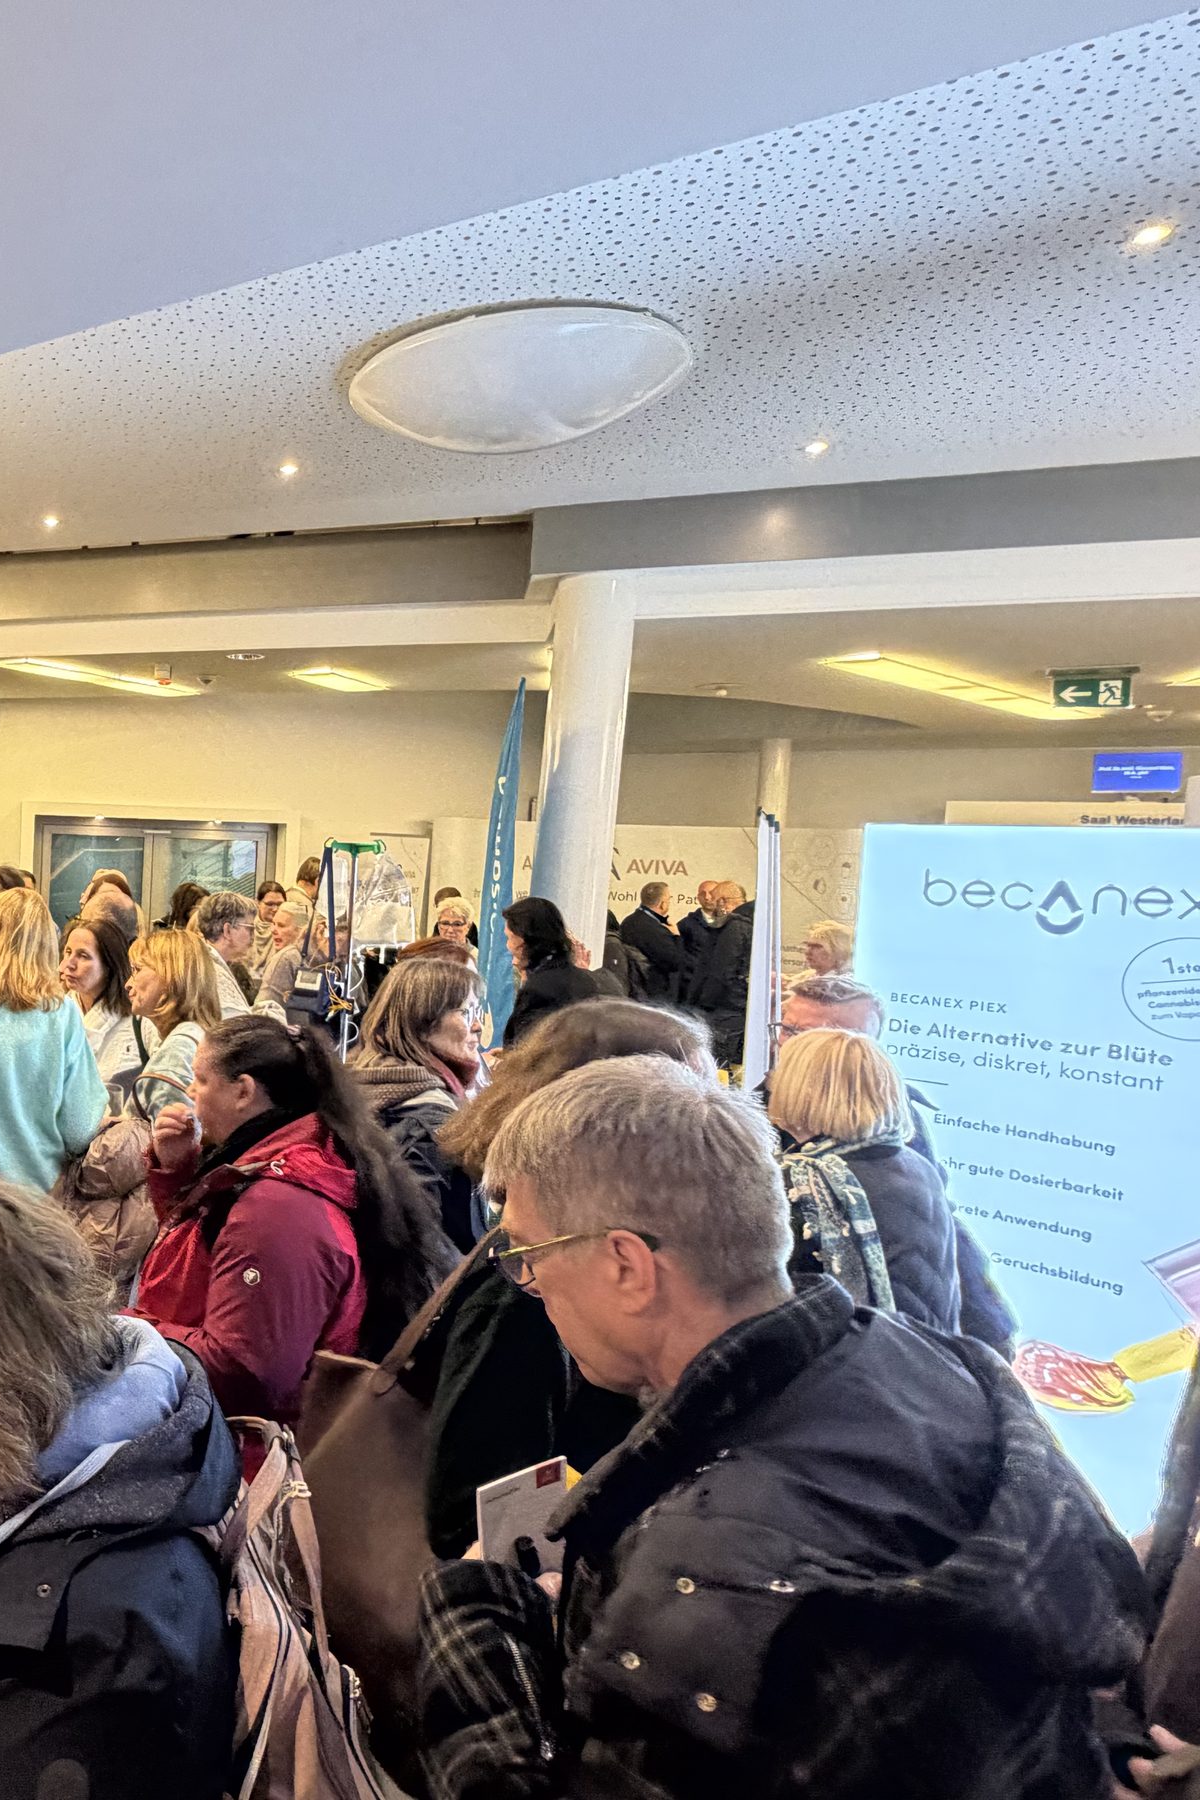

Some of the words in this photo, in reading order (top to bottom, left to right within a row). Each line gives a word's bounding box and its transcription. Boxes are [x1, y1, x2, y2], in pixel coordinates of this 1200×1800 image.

[1080, 815, 1111, 825] Saal
[626, 859, 688, 876] AVIVA
[677, 894, 698, 905] Pat
[890, 992, 964, 1009] BECANEX
[969, 1000, 1008, 1014] PIEX
[888, 1018, 921, 1035] Die
[927, 1022, 1053, 1052] Alternative
[1060, 1042, 1101, 1058] zur
[1107, 1043, 1174, 1067] Blüte
[973, 1050, 1051, 1080] diskret,
[1060, 1061, 1164, 1092] konstant
[934, 1113, 1001, 1134] Einfache
[1005, 1124, 1116, 1157] Handhabung
[969, 1163, 1005, 1179] gute
[1009, 1168, 1125, 1201] Dosierbarkeit
[958, 1204, 990, 1219] rete
[992, 1209, 1093, 1244] Anwendung
[990, 1252, 1124, 1297] Geruchsbildung
